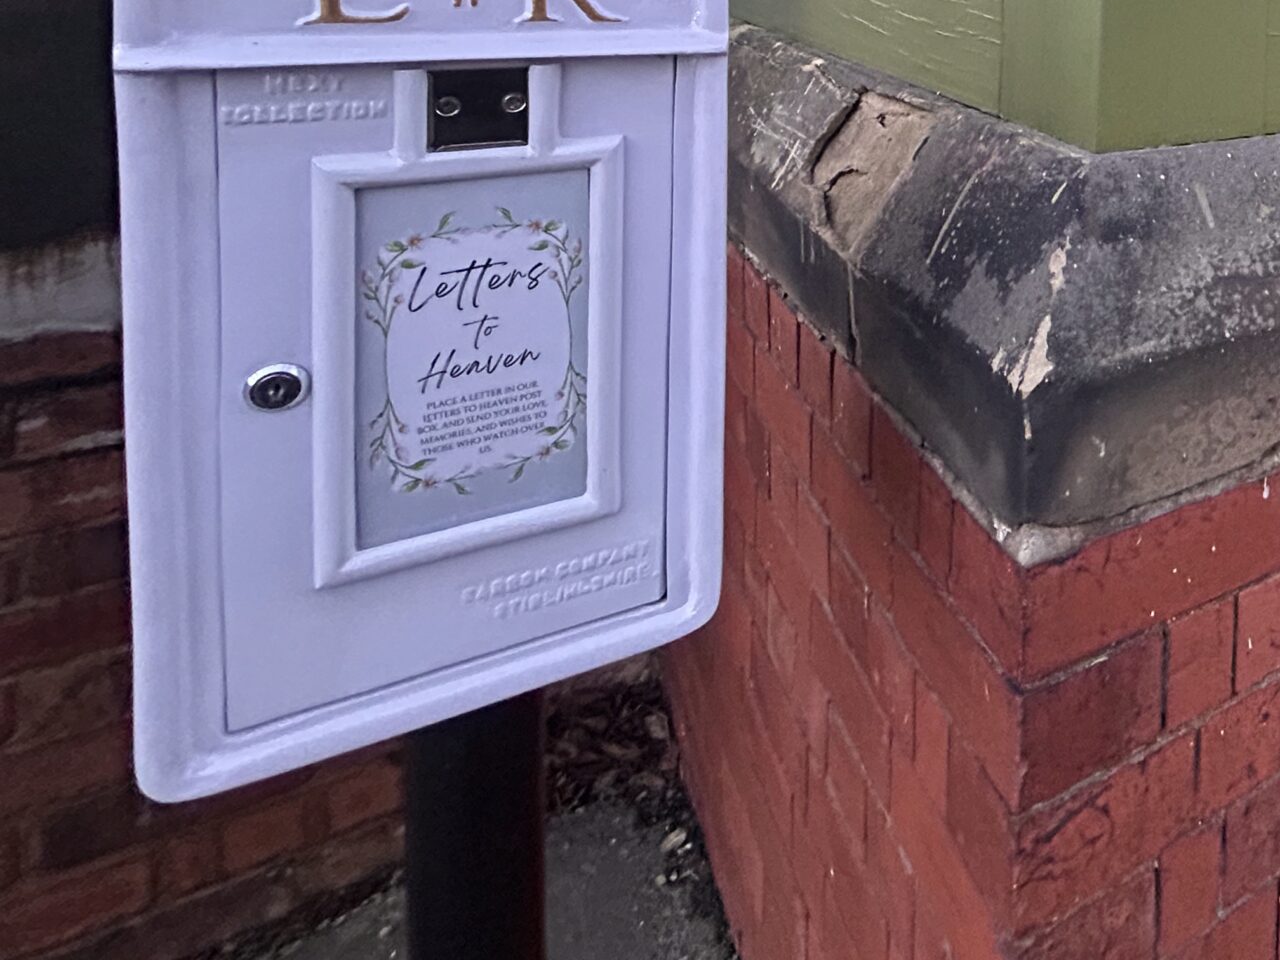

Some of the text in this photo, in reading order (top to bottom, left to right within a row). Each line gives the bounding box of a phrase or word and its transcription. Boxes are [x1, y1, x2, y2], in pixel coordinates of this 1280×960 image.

[408, 257, 550, 312] Letters
[463, 315, 499, 349] to
[417, 348, 541, 394] Heaven
[422, 390, 542, 423] LETTERS TO HEAVEN POST
[426, 397, 457, 410] PLACE
[468, 388, 502, 401] LETTER
[504, 384, 515, 394] IN
[516, 380, 539, 391] OUR
[441, 419, 465, 430] AND
[466, 413, 492, 424] SEND
[494, 406, 520, 418] YOUR
[475, 422, 498, 433] AND
[499, 414, 532, 428] WISHES
[534, 410, 548, 420] TO
[422, 421, 545, 456] THOSE WHO WATCH OVER
